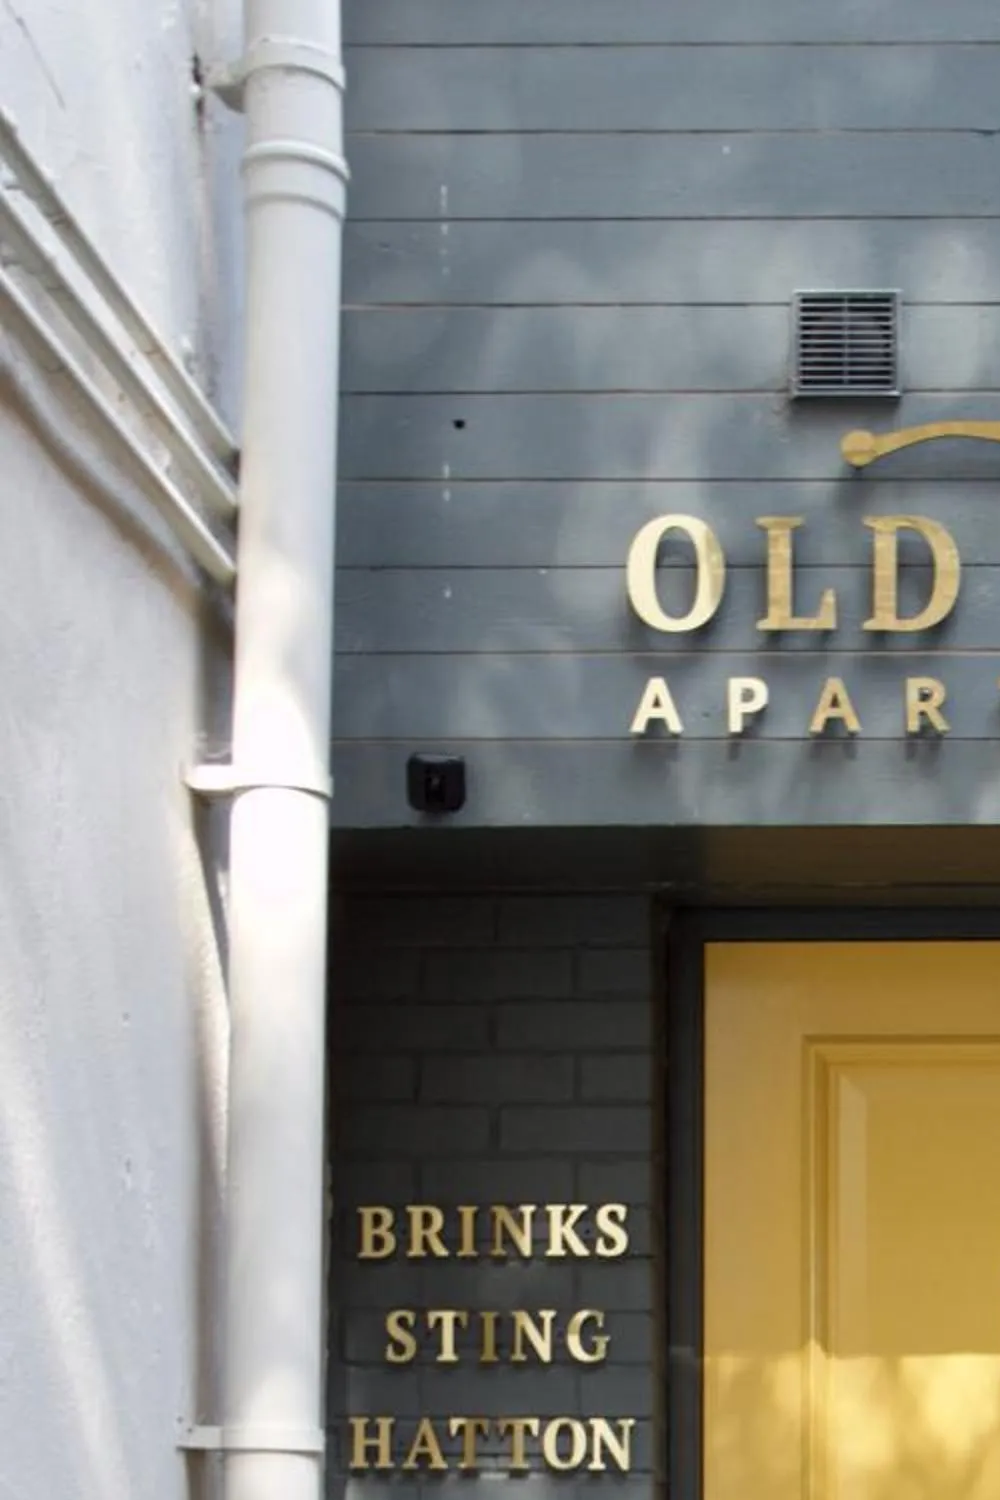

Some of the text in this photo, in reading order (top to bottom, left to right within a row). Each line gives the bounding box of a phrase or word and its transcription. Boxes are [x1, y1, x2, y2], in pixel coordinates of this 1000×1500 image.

[625, 513, 962, 633] OLD
[357, 1204, 628, 1257] BRINKS
[385, 1310, 610, 1363] STING
[348, 1417, 635, 1470] HATTON
